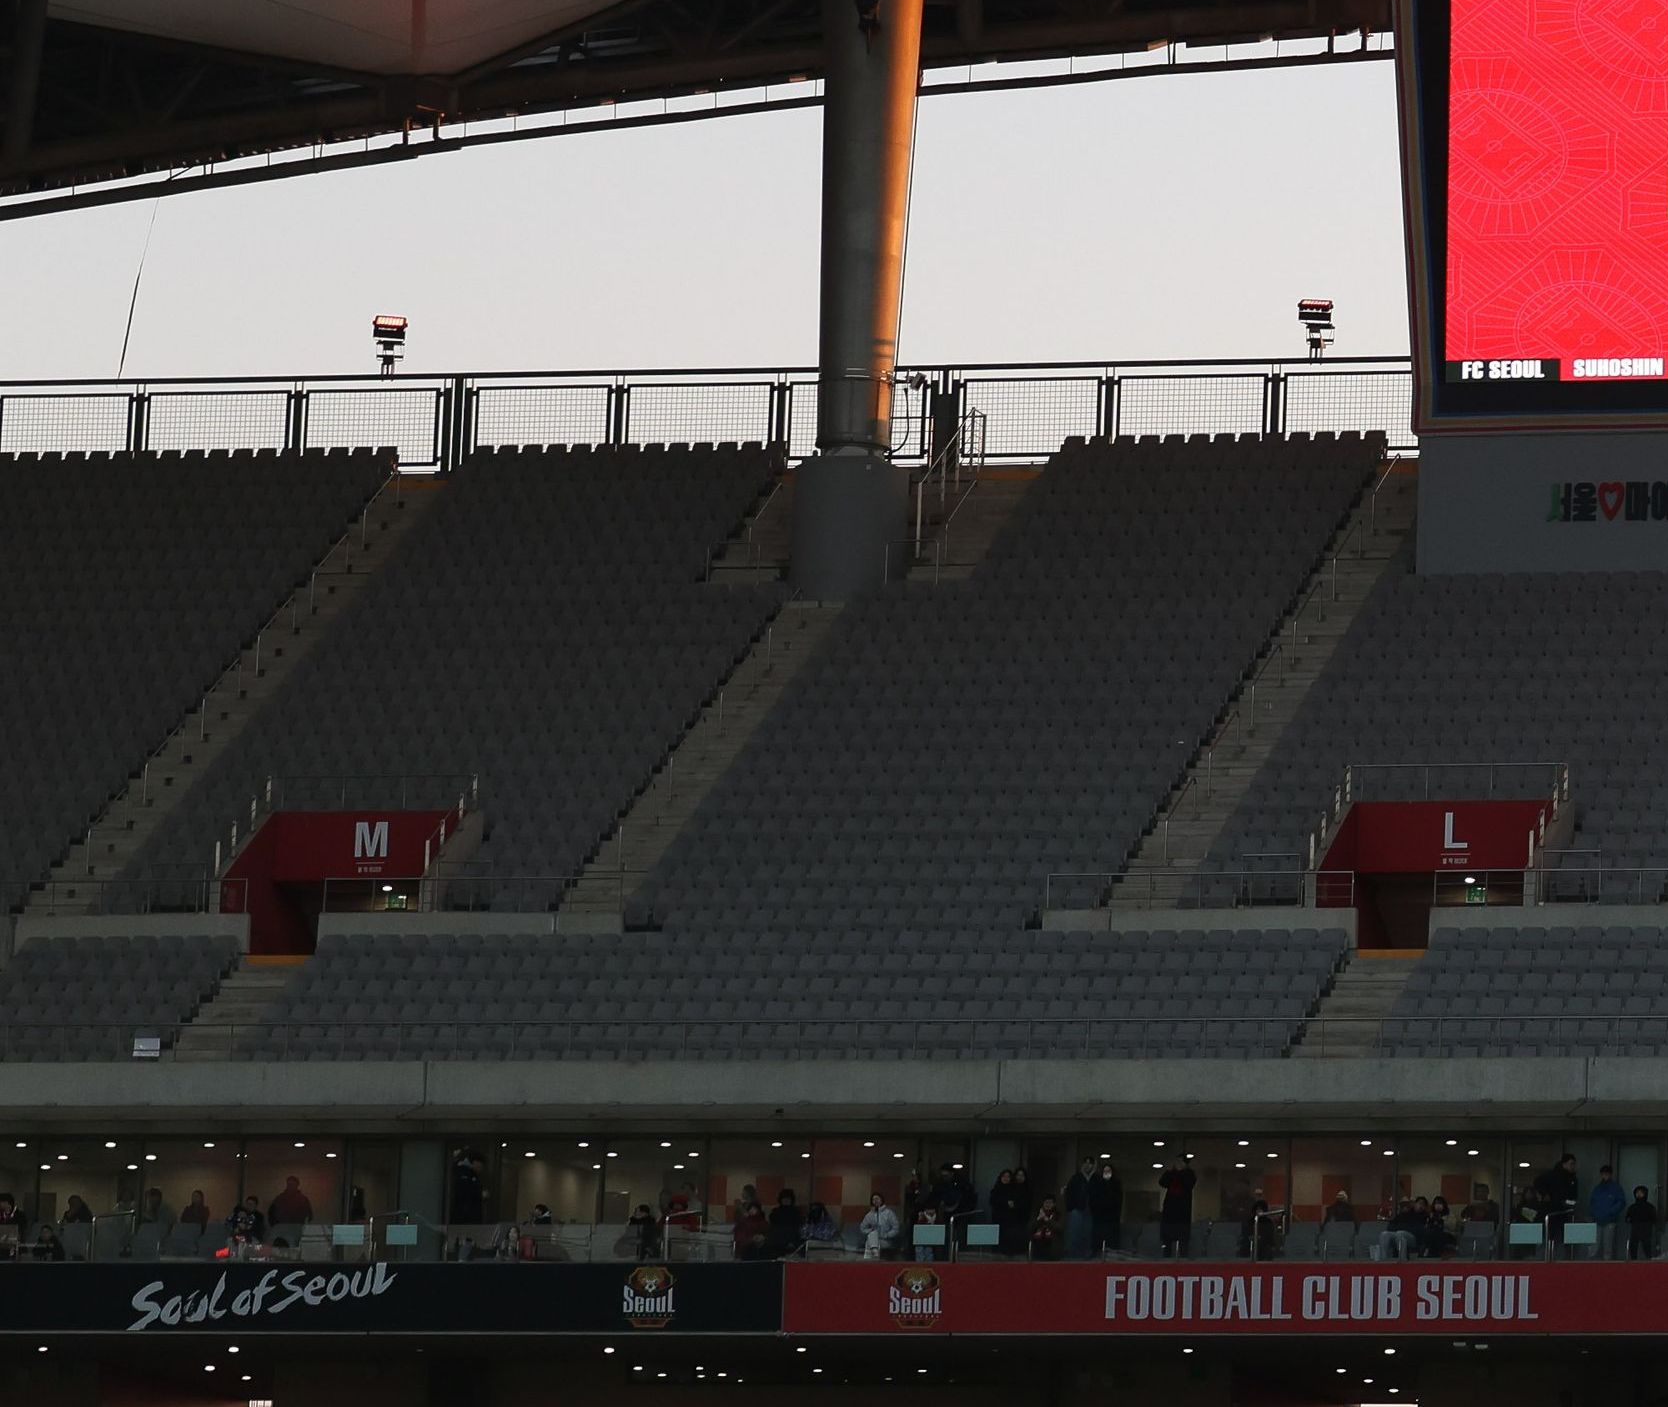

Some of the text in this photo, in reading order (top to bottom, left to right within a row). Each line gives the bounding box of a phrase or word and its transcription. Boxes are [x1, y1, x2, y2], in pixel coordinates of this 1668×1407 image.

[1462, 361, 1483, 379] FC
[1489, 360, 1544, 378] SEOUL
[1574, 358, 1663, 377] SUHOSHIN
[354, 821, 389, 858] M
[1445, 812, 1468, 849] L
[232, 1268, 278, 1317] of
[268, 1262, 397, 1313] Seoul
[623, 1284, 676, 1314] Seoul
[889, 1285, 942, 1314] Seoul
[1105, 1276, 1539, 1320] FOOTBALL CLUB SEOUL
